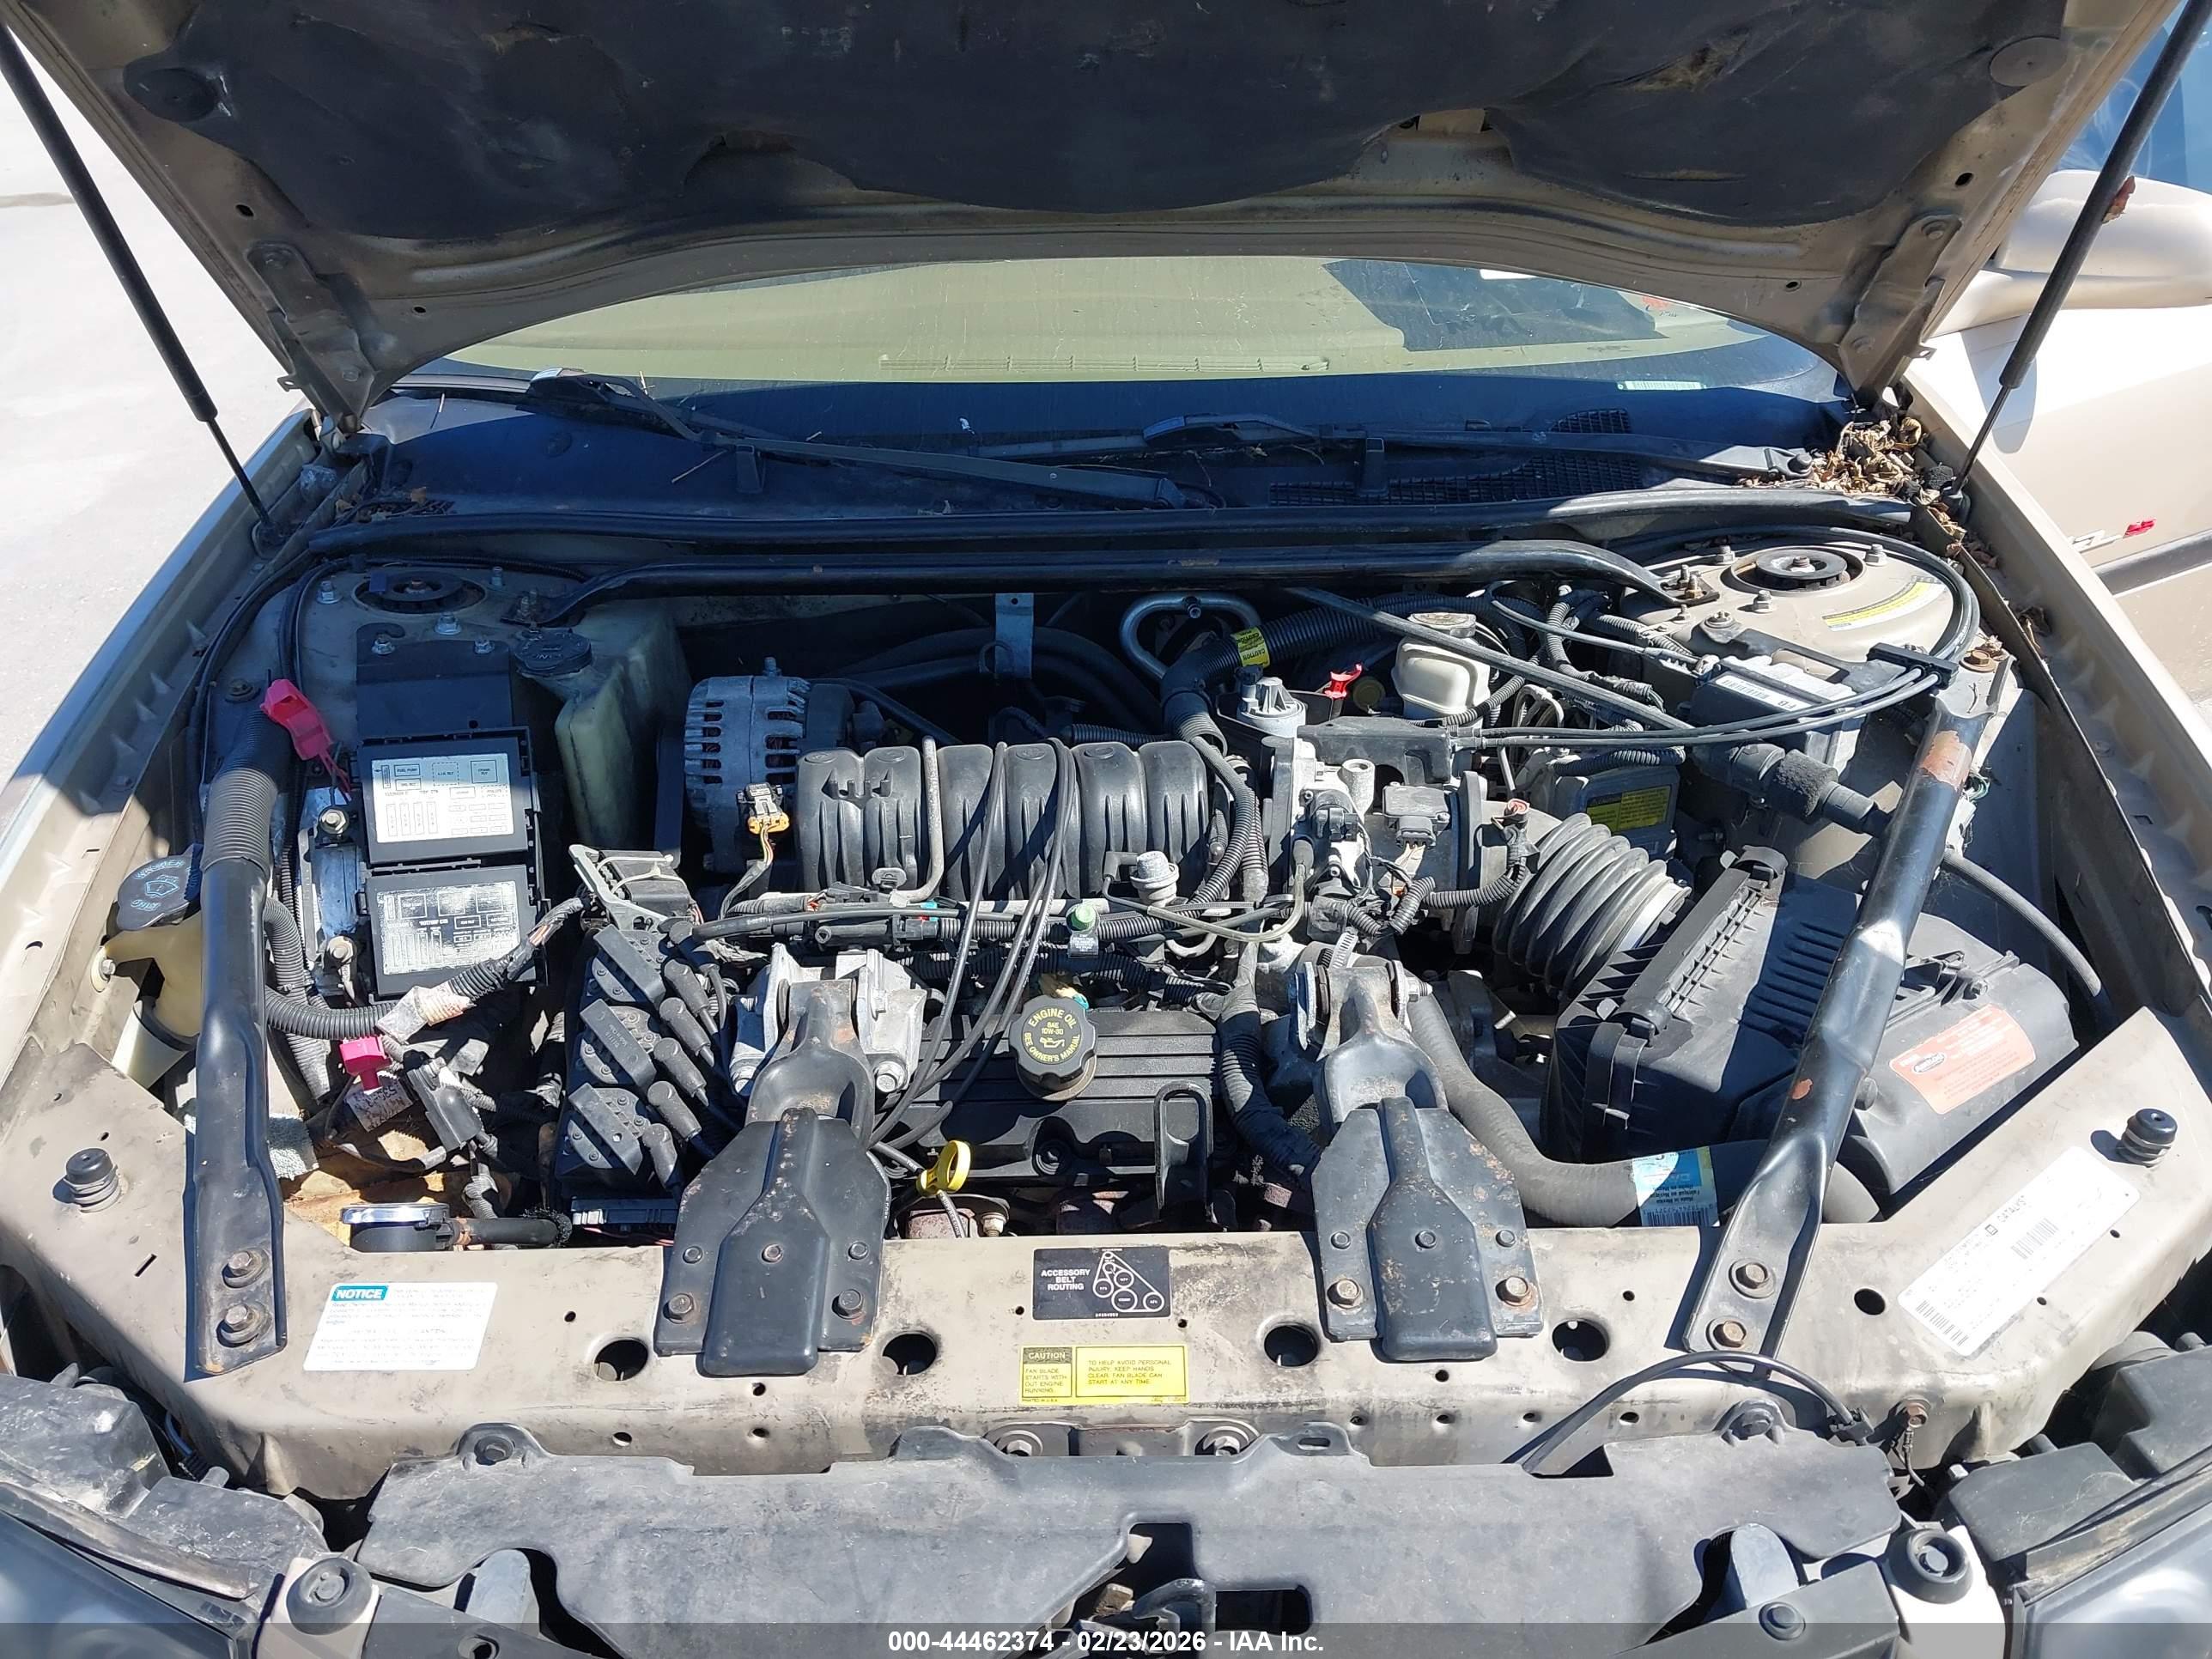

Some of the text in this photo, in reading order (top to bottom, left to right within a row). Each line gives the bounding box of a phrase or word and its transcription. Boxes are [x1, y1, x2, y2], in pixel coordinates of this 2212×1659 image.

[1028, 1007, 1078, 1030] ENGINE OIL
[1029, 1046, 1060, 1062] OWNER'S
[1060, 1034, 1081, 1060] MANUAL
[336, 1289, 383, 1299] NOTICE
[1029, 1352, 1066, 1360] CAUTION
